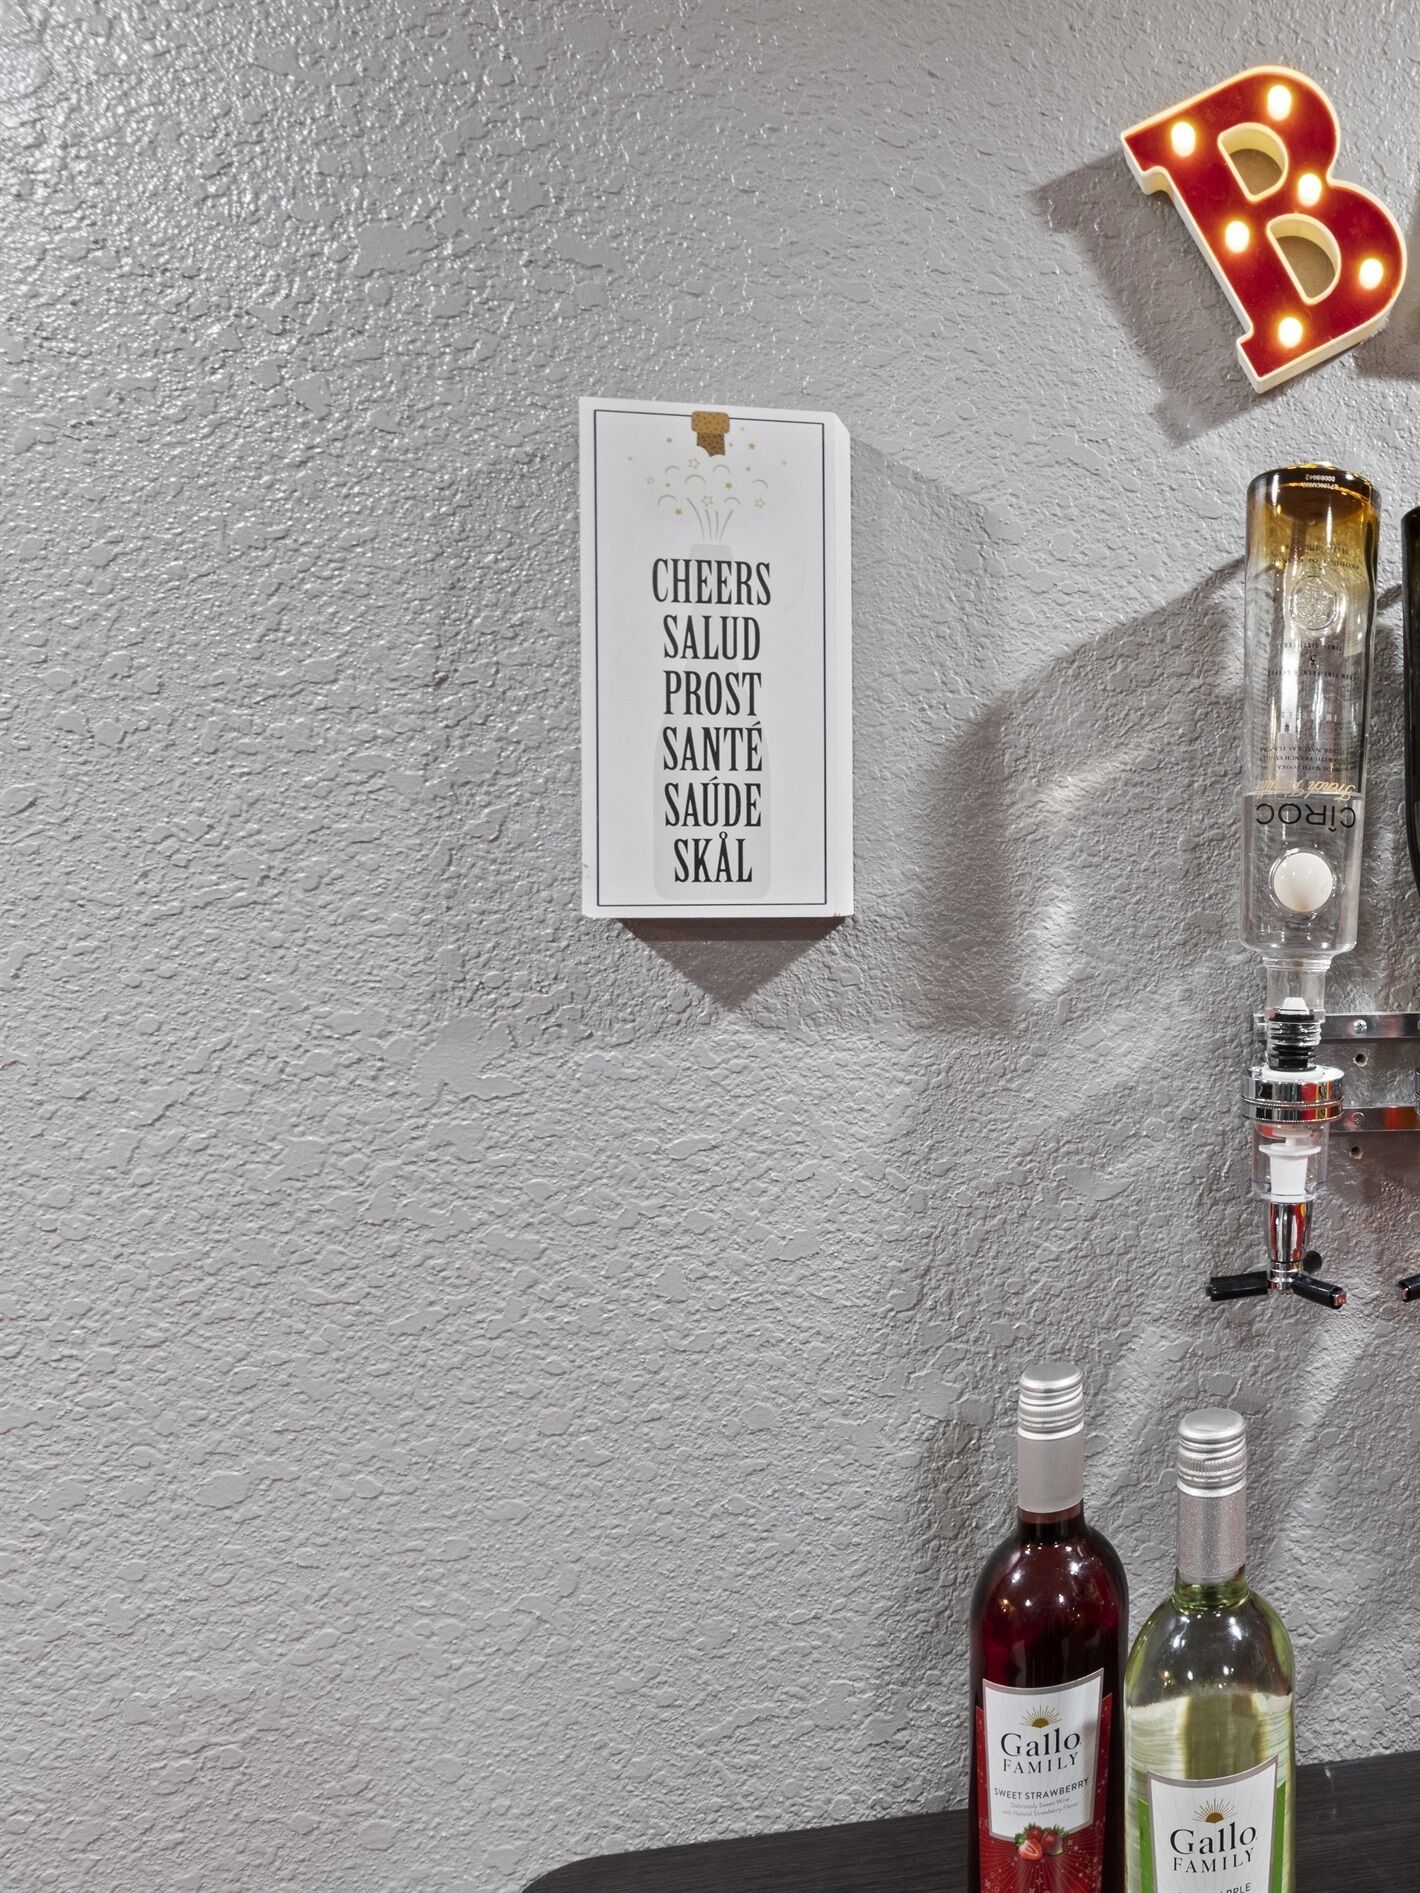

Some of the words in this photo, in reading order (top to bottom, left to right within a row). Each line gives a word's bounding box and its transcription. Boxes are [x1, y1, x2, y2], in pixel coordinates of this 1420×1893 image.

[652, 558, 771, 606] CHEERS
[663, 615, 760, 660] SALUD
[663, 670, 761, 717] PROST
[662, 721, 763, 772] SANTÉ
[664, 776, 762, 828] SAÚDE
[1304, 781, 1356, 801] French
[674, 831, 753, 883] SKÅL
[1001, 1727, 1080, 1757] Gallo
[1003, 1752, 1078, 1774] FAMILY
[994, 1787, 1022, 1800] SWEET
[1025, 1777, 1090, 1800] STRAWBERRY
[1170, 1821, 1257, 1856] Gallo
[1173, 1847, 1254, 1873] FAMILY
[1220, 1882, 1251, 1893] PLE
